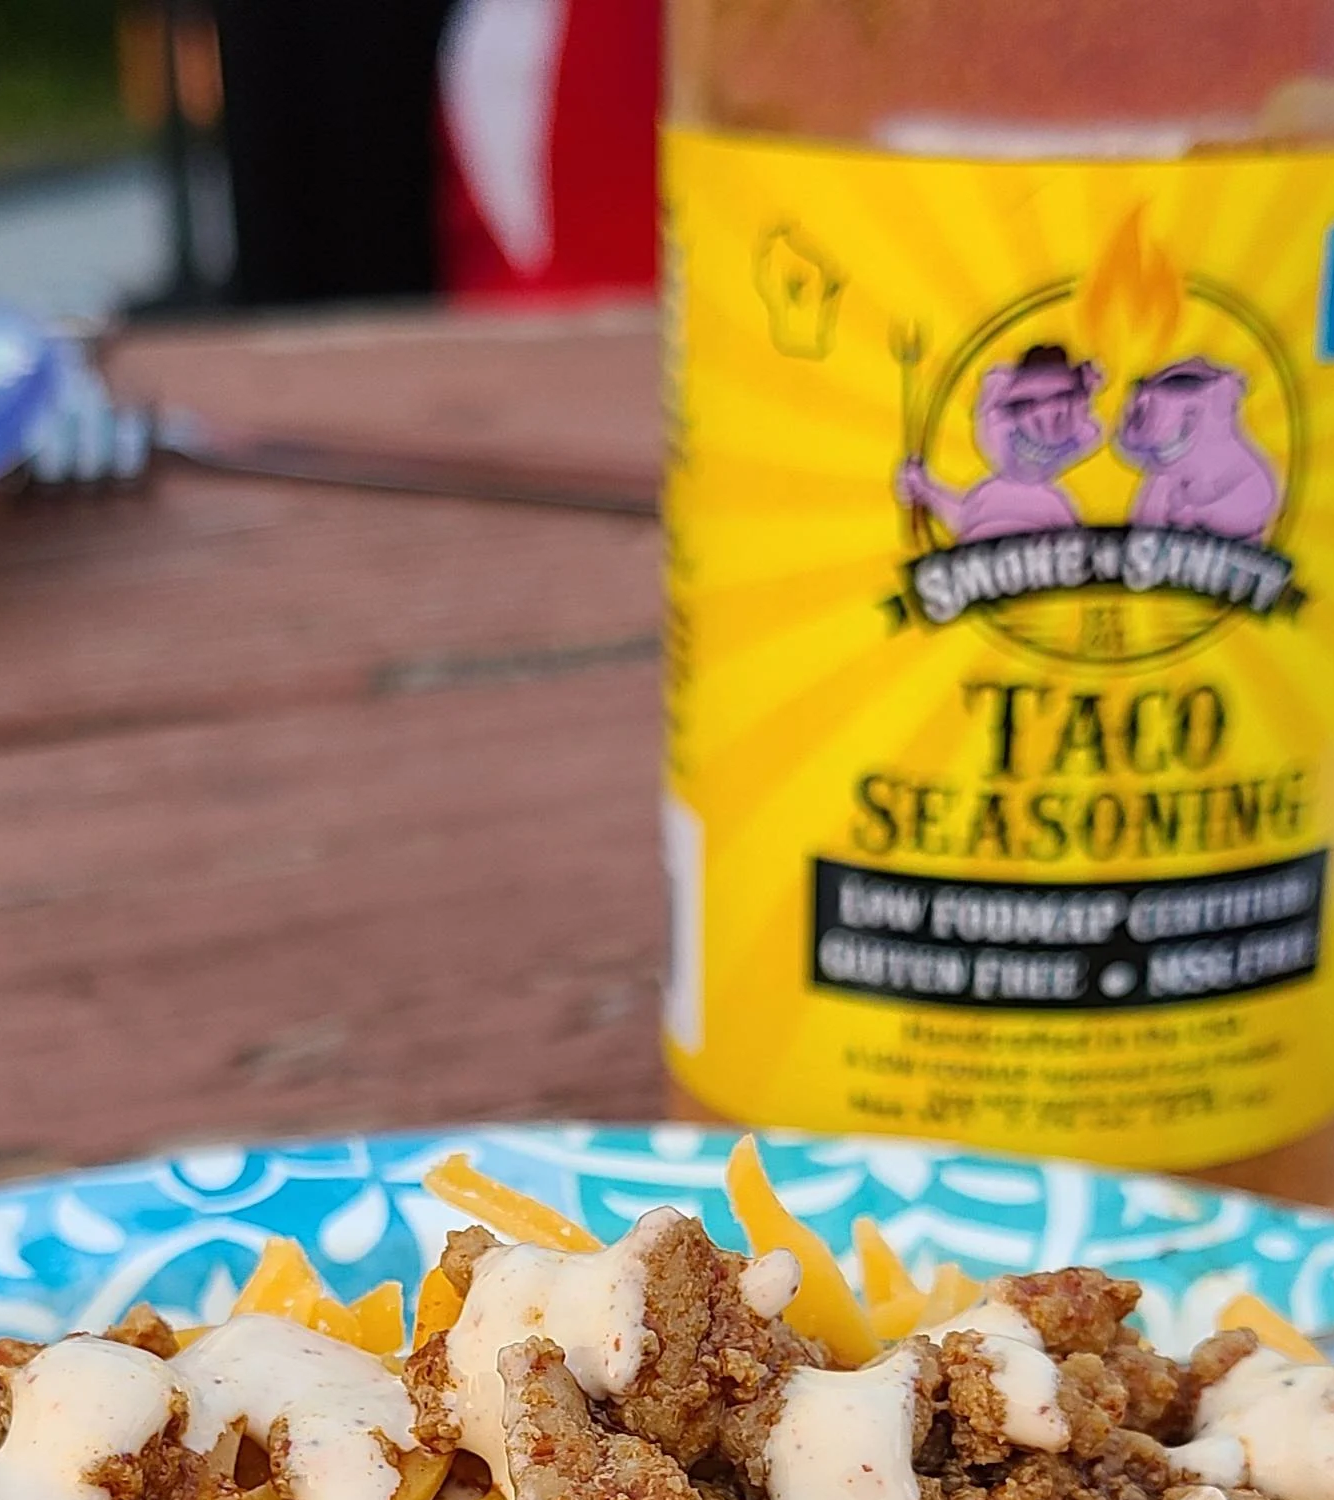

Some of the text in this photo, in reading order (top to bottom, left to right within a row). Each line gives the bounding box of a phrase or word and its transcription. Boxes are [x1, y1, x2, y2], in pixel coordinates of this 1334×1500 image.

[914, 530, 1087, 624] SMOKE
[1122, 530, 1291, 613] SANITY
[961, 681, 1227, 778] TACO
[851, 768, 1308, 864] SEASONING
[838, 868, 930, 932] LOW
[818, 927, 969, 997] GLUTEN
[971, 947, 1091, 1001] FREE
